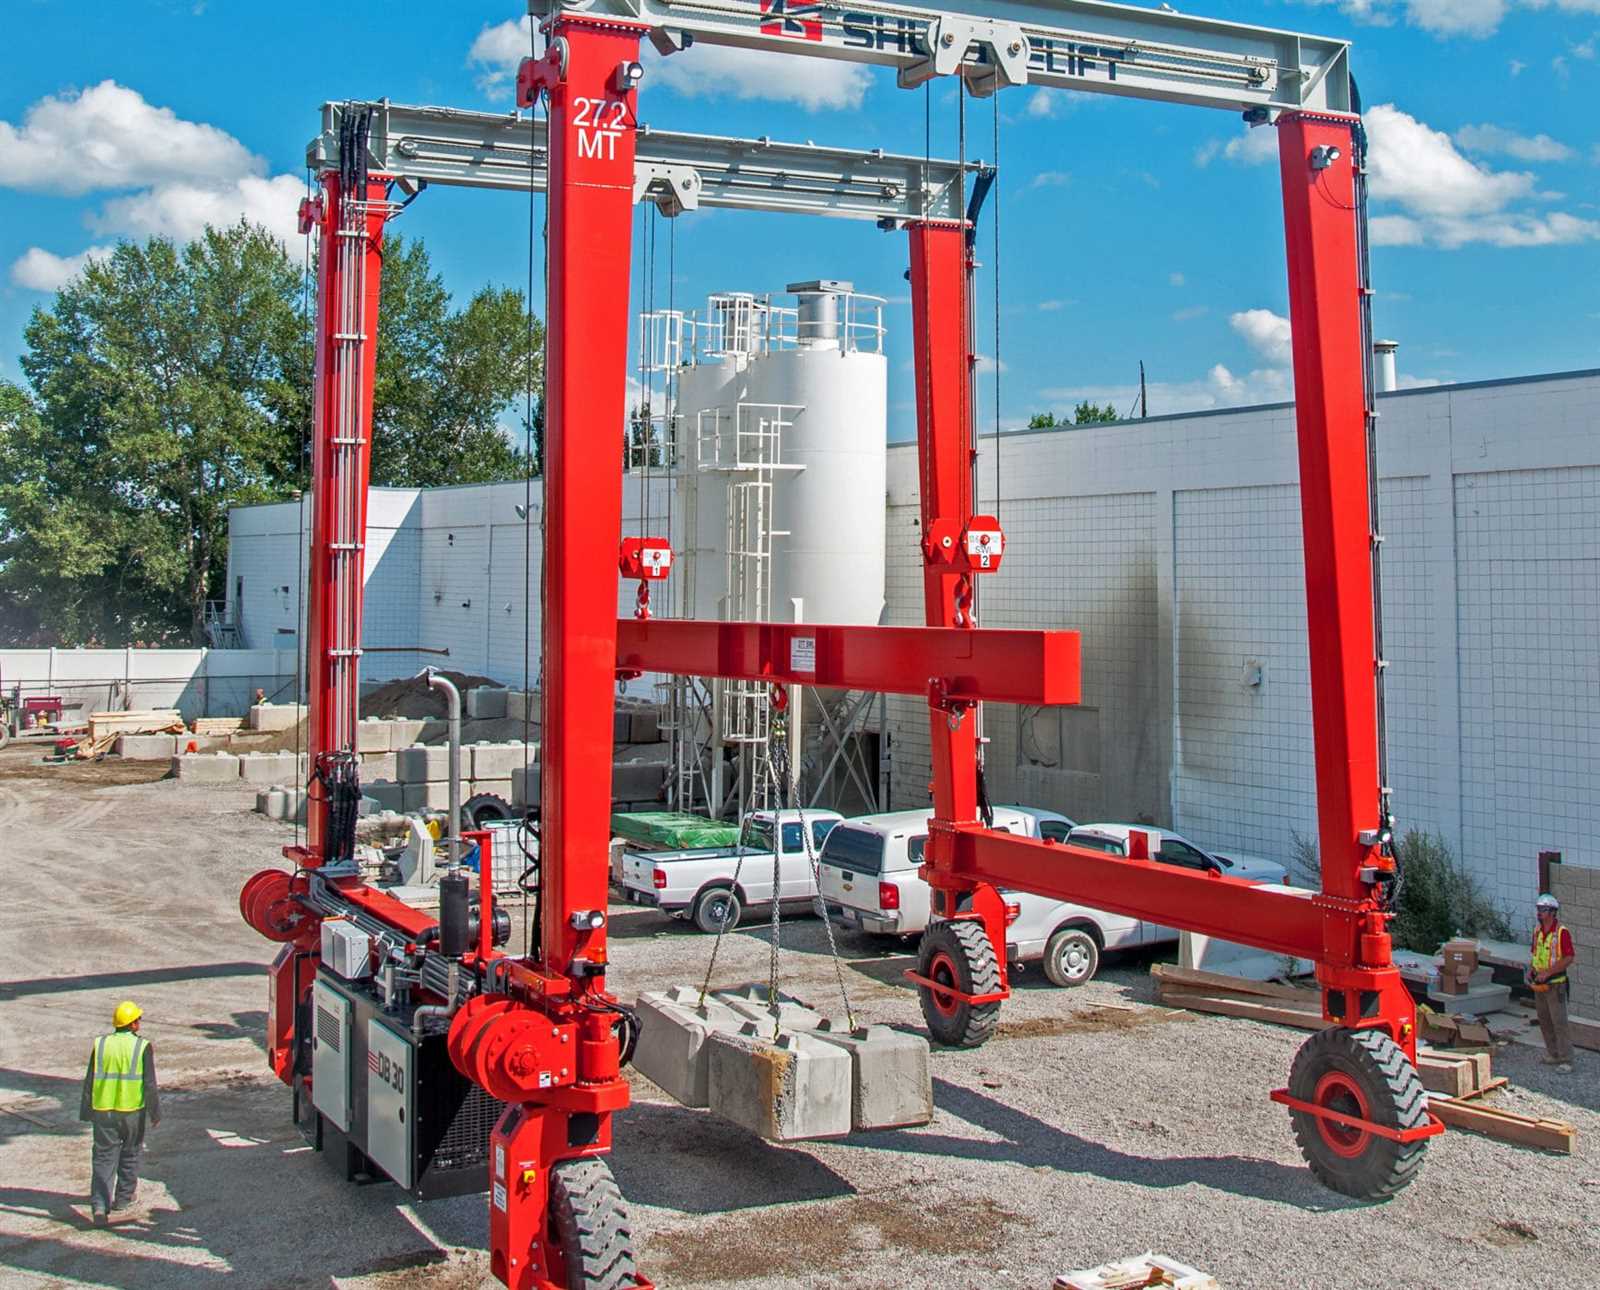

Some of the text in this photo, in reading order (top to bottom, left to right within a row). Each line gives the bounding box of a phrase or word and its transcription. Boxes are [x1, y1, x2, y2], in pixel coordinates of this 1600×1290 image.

[573, 97, 627, 130] 27.2
[578, 129, 622, 161] MT
[982, 555, 989, 566] 2
[392, 1061, 404, 1095] 30
